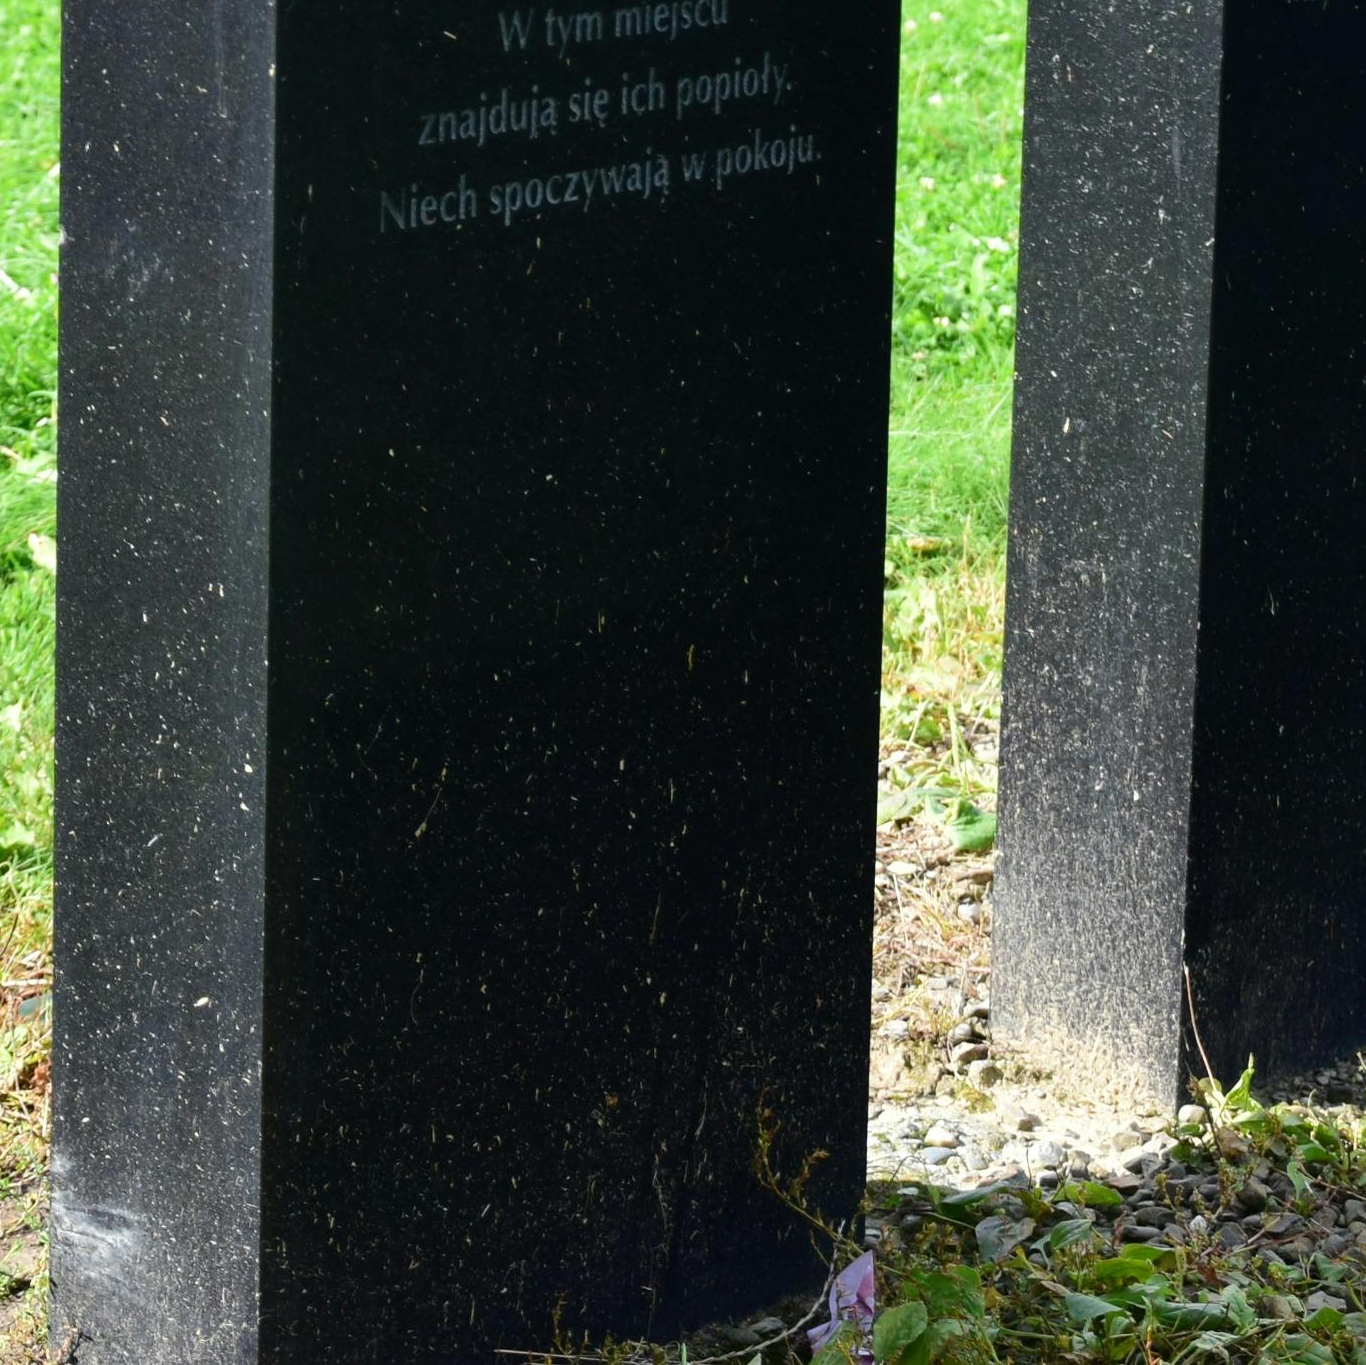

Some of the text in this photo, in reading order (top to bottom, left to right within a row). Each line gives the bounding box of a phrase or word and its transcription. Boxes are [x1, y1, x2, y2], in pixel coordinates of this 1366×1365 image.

[498, 9, 534, 51] W
[545, 6, 603, 58] tym
[418, 52, 792, 146] znajdują się ich popioły.
[380, 124, 822, 233] Niech spoczywają w pokoju.
